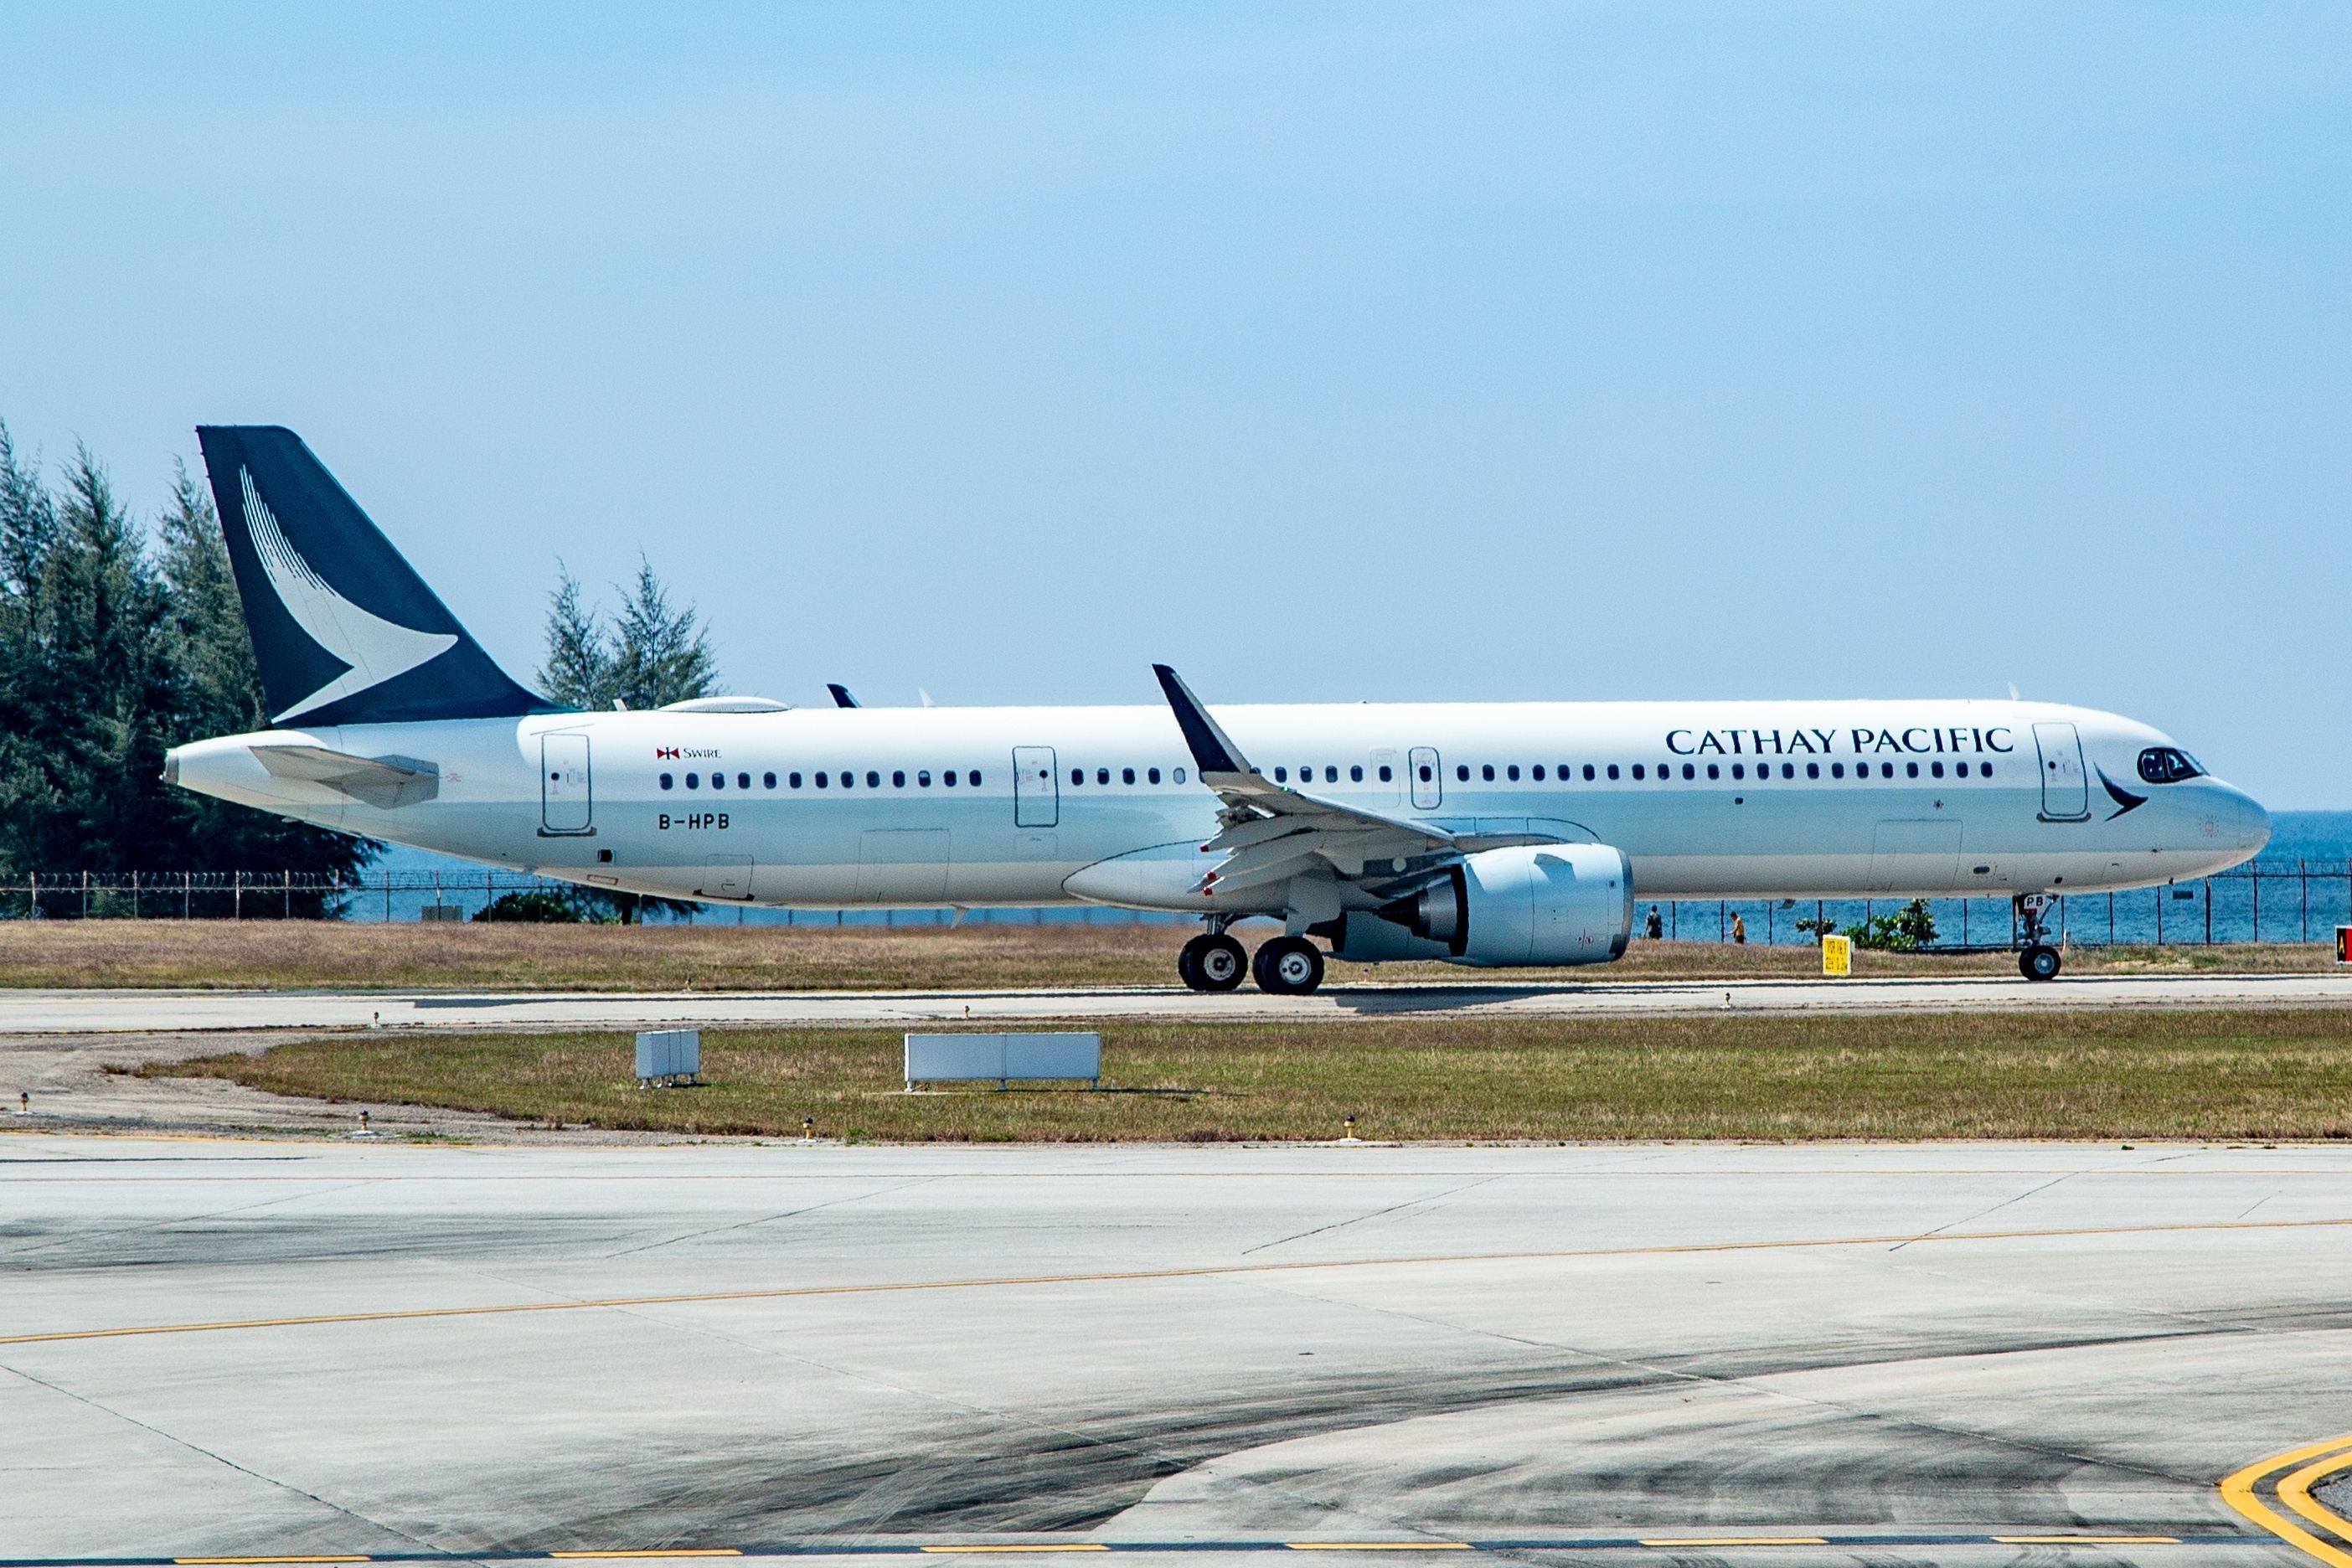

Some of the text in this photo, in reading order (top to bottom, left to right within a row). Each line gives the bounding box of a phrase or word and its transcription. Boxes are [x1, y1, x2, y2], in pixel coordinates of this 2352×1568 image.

[1665, 727, 2014, 755] CATHAY PACIFIC
[659, 812, 730, 829] B-HPB
[2339, 936, 2345, 954] A
